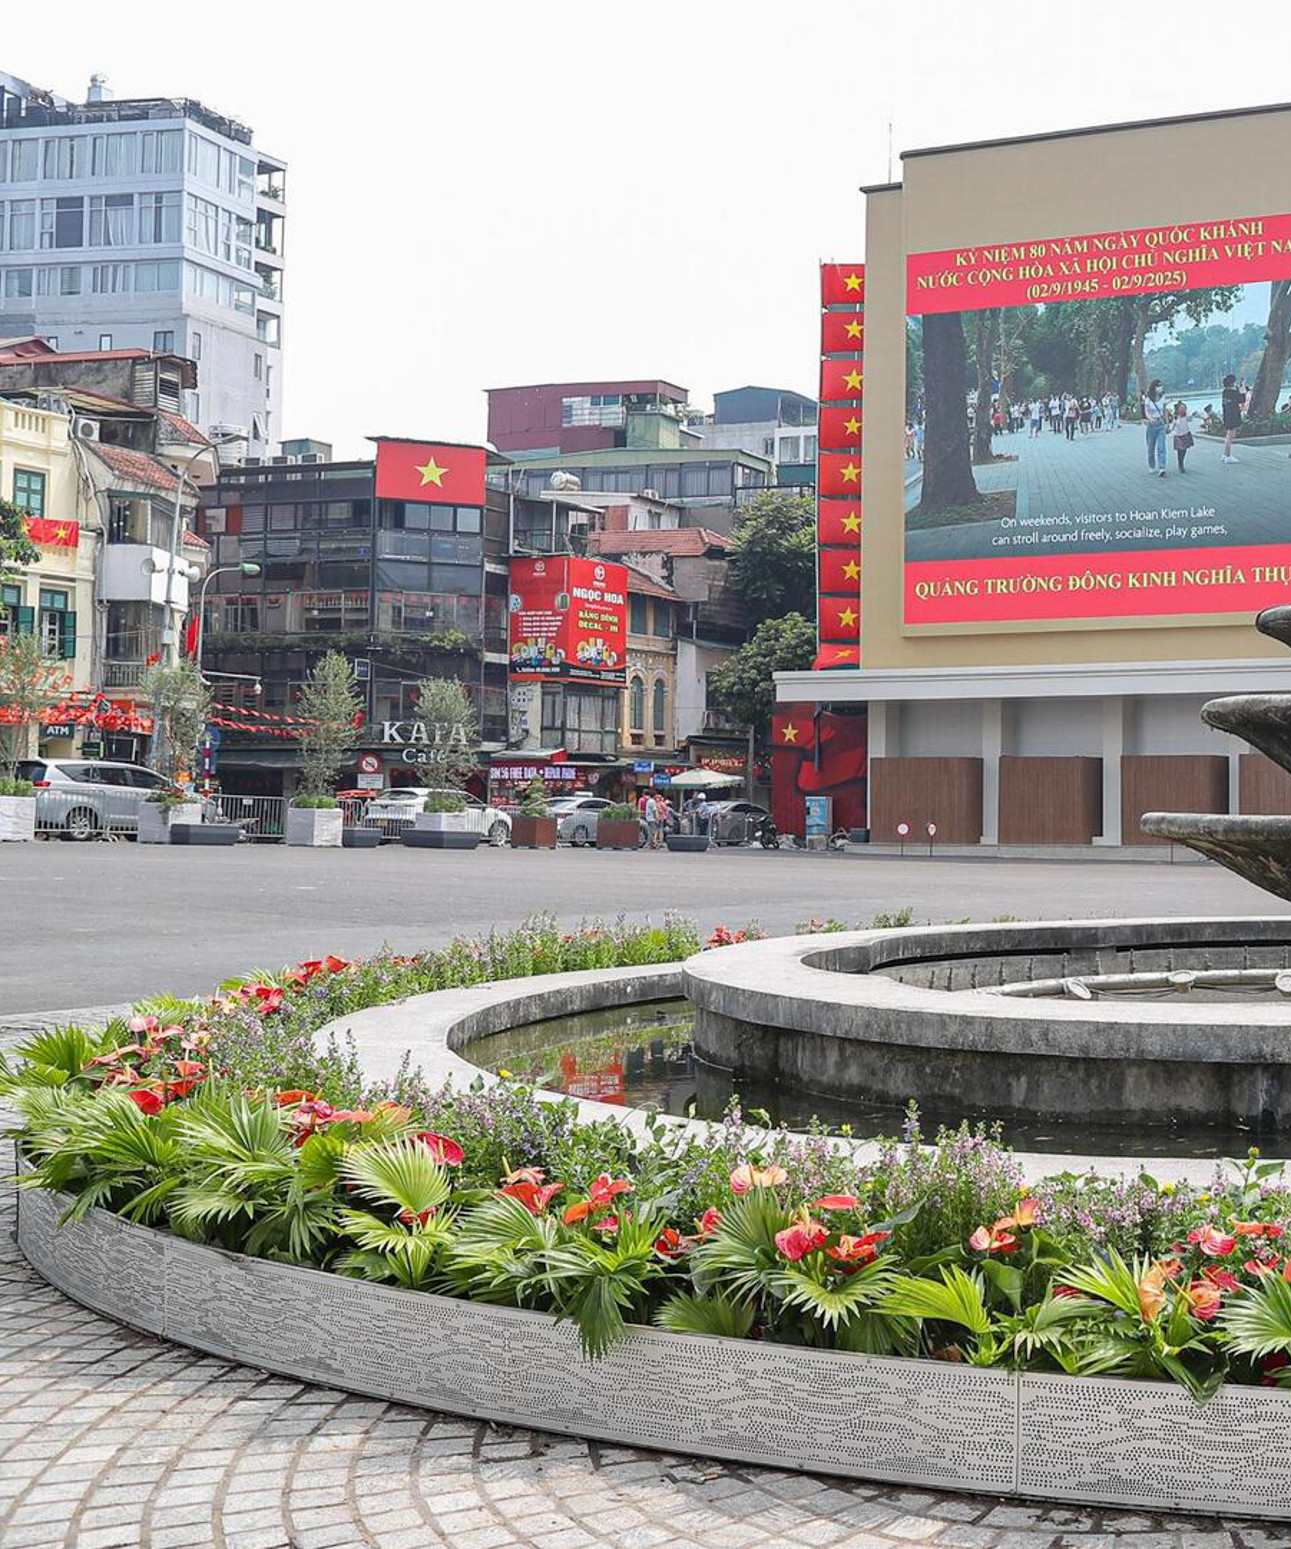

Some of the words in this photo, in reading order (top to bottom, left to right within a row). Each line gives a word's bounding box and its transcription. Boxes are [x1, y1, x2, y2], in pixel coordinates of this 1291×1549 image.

[956, 246, 979, 266] KỶ
[983, 246, 1025, 264] NIỆM
[1029, 244, 1046, 258] 80
[1050, 236, 1088, 256] NĂM
[1092, 232, 1140, 252] NGÀY
[1144, 225, 1195, 246] QUỐC
[1200, 220, 1264, 241] KHÁNH
[916, 269, 963, 290] NƯỚC
[967, 268, 1014, 286] CỘNG
[1018, 262, 1054, 280] HÒA
[1058, 258, 1081, 275] XÃ
[1086, 255, 1117, 274] HỘI
[1122, 250, 1158, 269] CHỦ
[1162, 244, 1220, 264] NGHĨA
[1224, 241, 1266, 260] VIỆT
[1026, 278, 1099, 300] (02/9/1945
[1112, 270, 1187, 290] 02/9/2025)
[1001, 516, 1017, 529] On
[1020, 514, 1072, 527] weekends,
[1075, 511, 1113, 524] visitors
[1115, 511, 1127, 522] to
[1130, 509, 1158, 522] Hoan
[1161, 507, 1188, 520] Kiem
[1190, 506, 1216, 518] Lake
[992, 535, 1011, 546] can
[1013, 532, 1039, 545] stroll
[1041, 530, 1078, 543] around
[1081, 527, 1113, 542] freely,
[1116, 526, 1163, 540] socialize,
[1166, 523, 1188, 538] play
[1190, 524, 1228, 538] games,
[984, 574, 1062, 594] TRƯỜNG
[1068, 570, 1122, 590] ĐÔNG
[1128, 571, 1176, 588] KINH
[1182, 565, 1246, 585] NGHĨA
[572, 586, 602, 602] NGỌC
[604, 592, 624, 604] HOA
[46, 726, 70, 735] ATM
